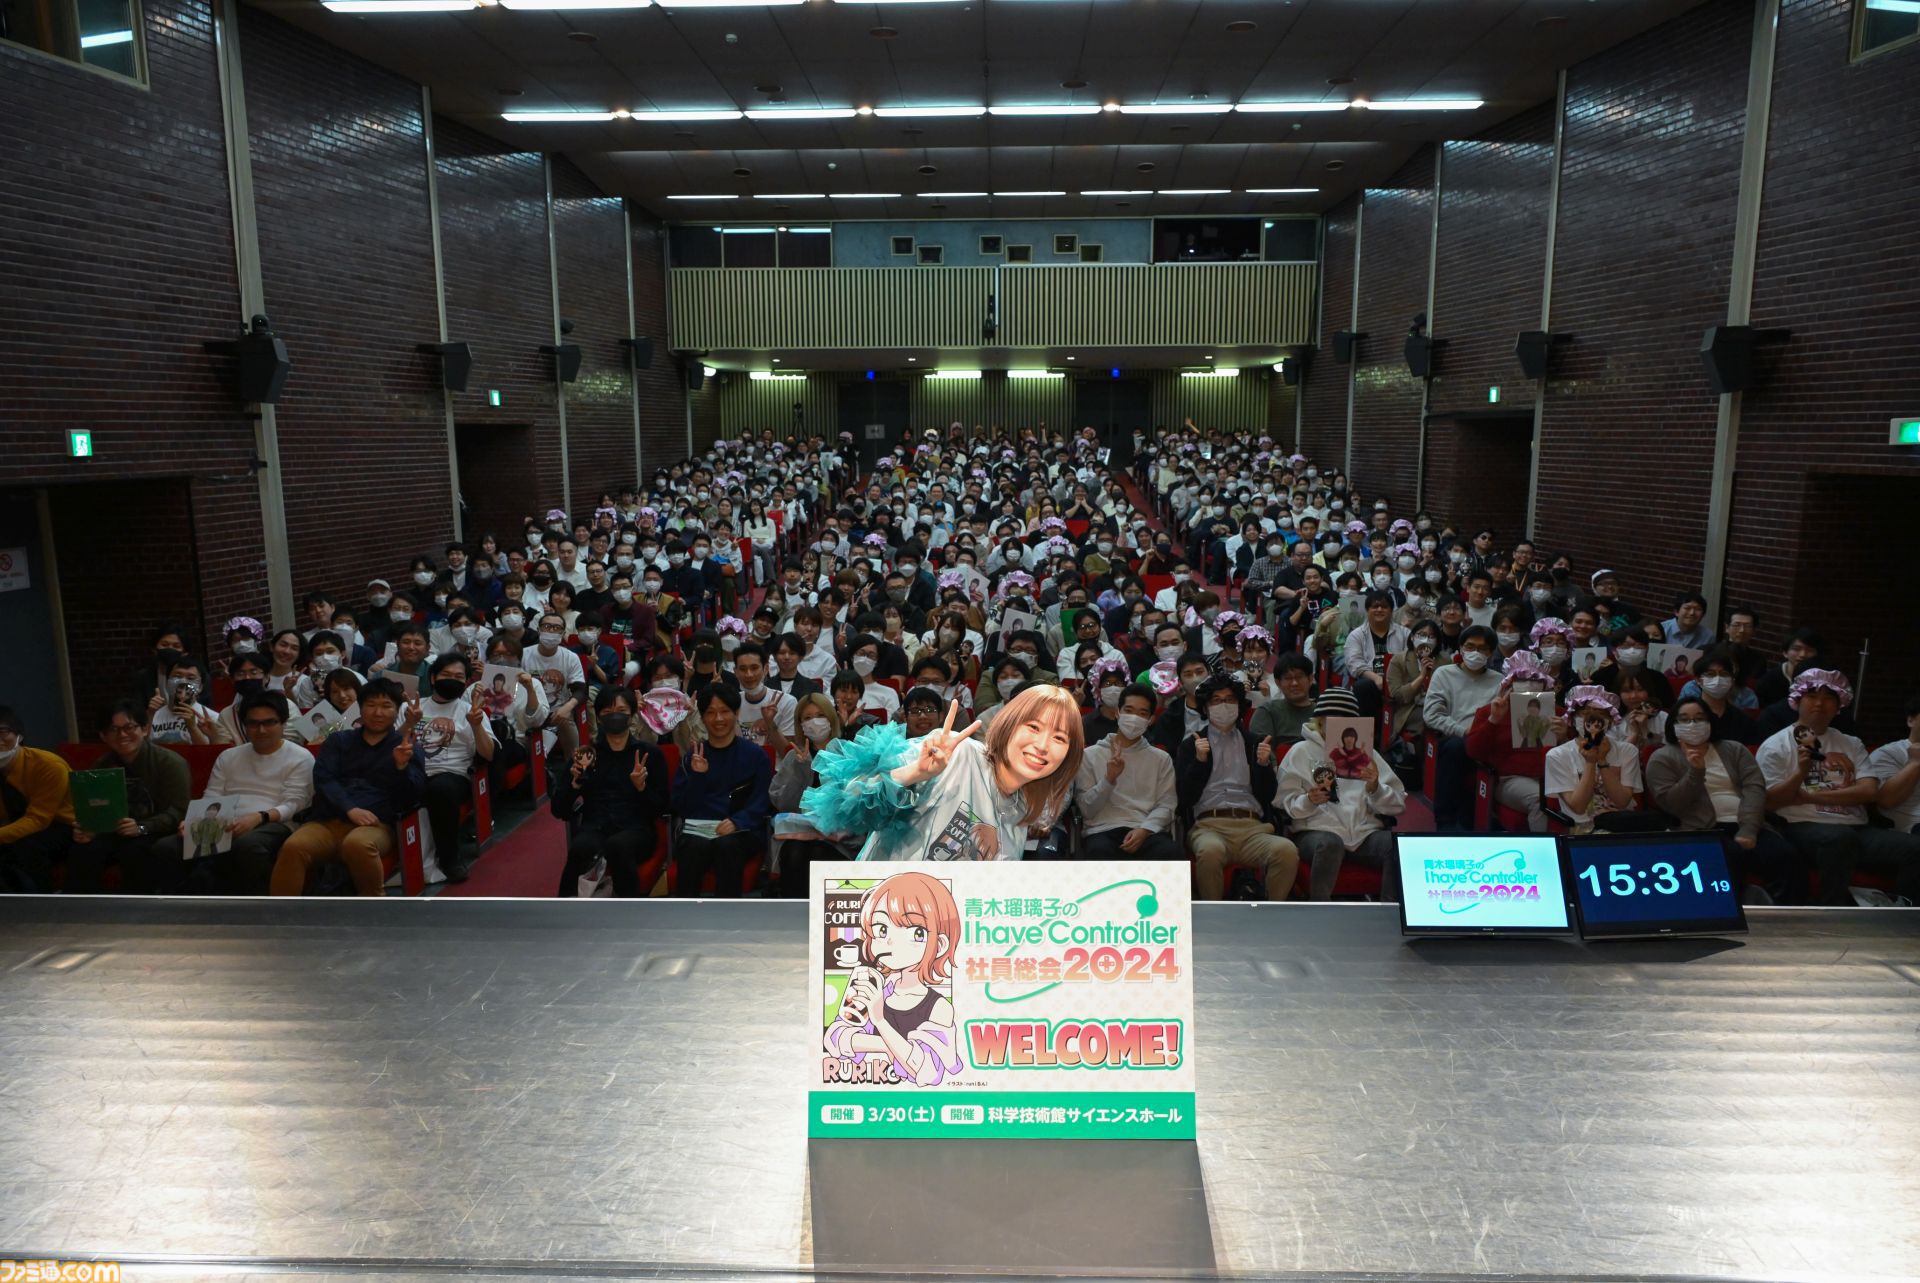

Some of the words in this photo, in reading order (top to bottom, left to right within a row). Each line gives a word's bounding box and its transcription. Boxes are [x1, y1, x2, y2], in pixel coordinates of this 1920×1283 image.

[1469, 871, 1538, 884] Controller
[1579, 861, 1703, 897] 15:31
[1710, 880, 1730, 892] 19
[964, 898, 1079, 917] 青木瑠璃子の
[825, 912, 861, 924] COFF
[1048, 920, 1178, 944] Controller
[970, 1023, 1180, 1066] WELCOME!
[830, 1108, 855, 1121] 開催
[868, 1106, 935, 1123] 3/30(土)
[950, 1108, 975, 1121] 開催
[988, 1107, 1183, 1123] 科学技術館サイエンスホール
